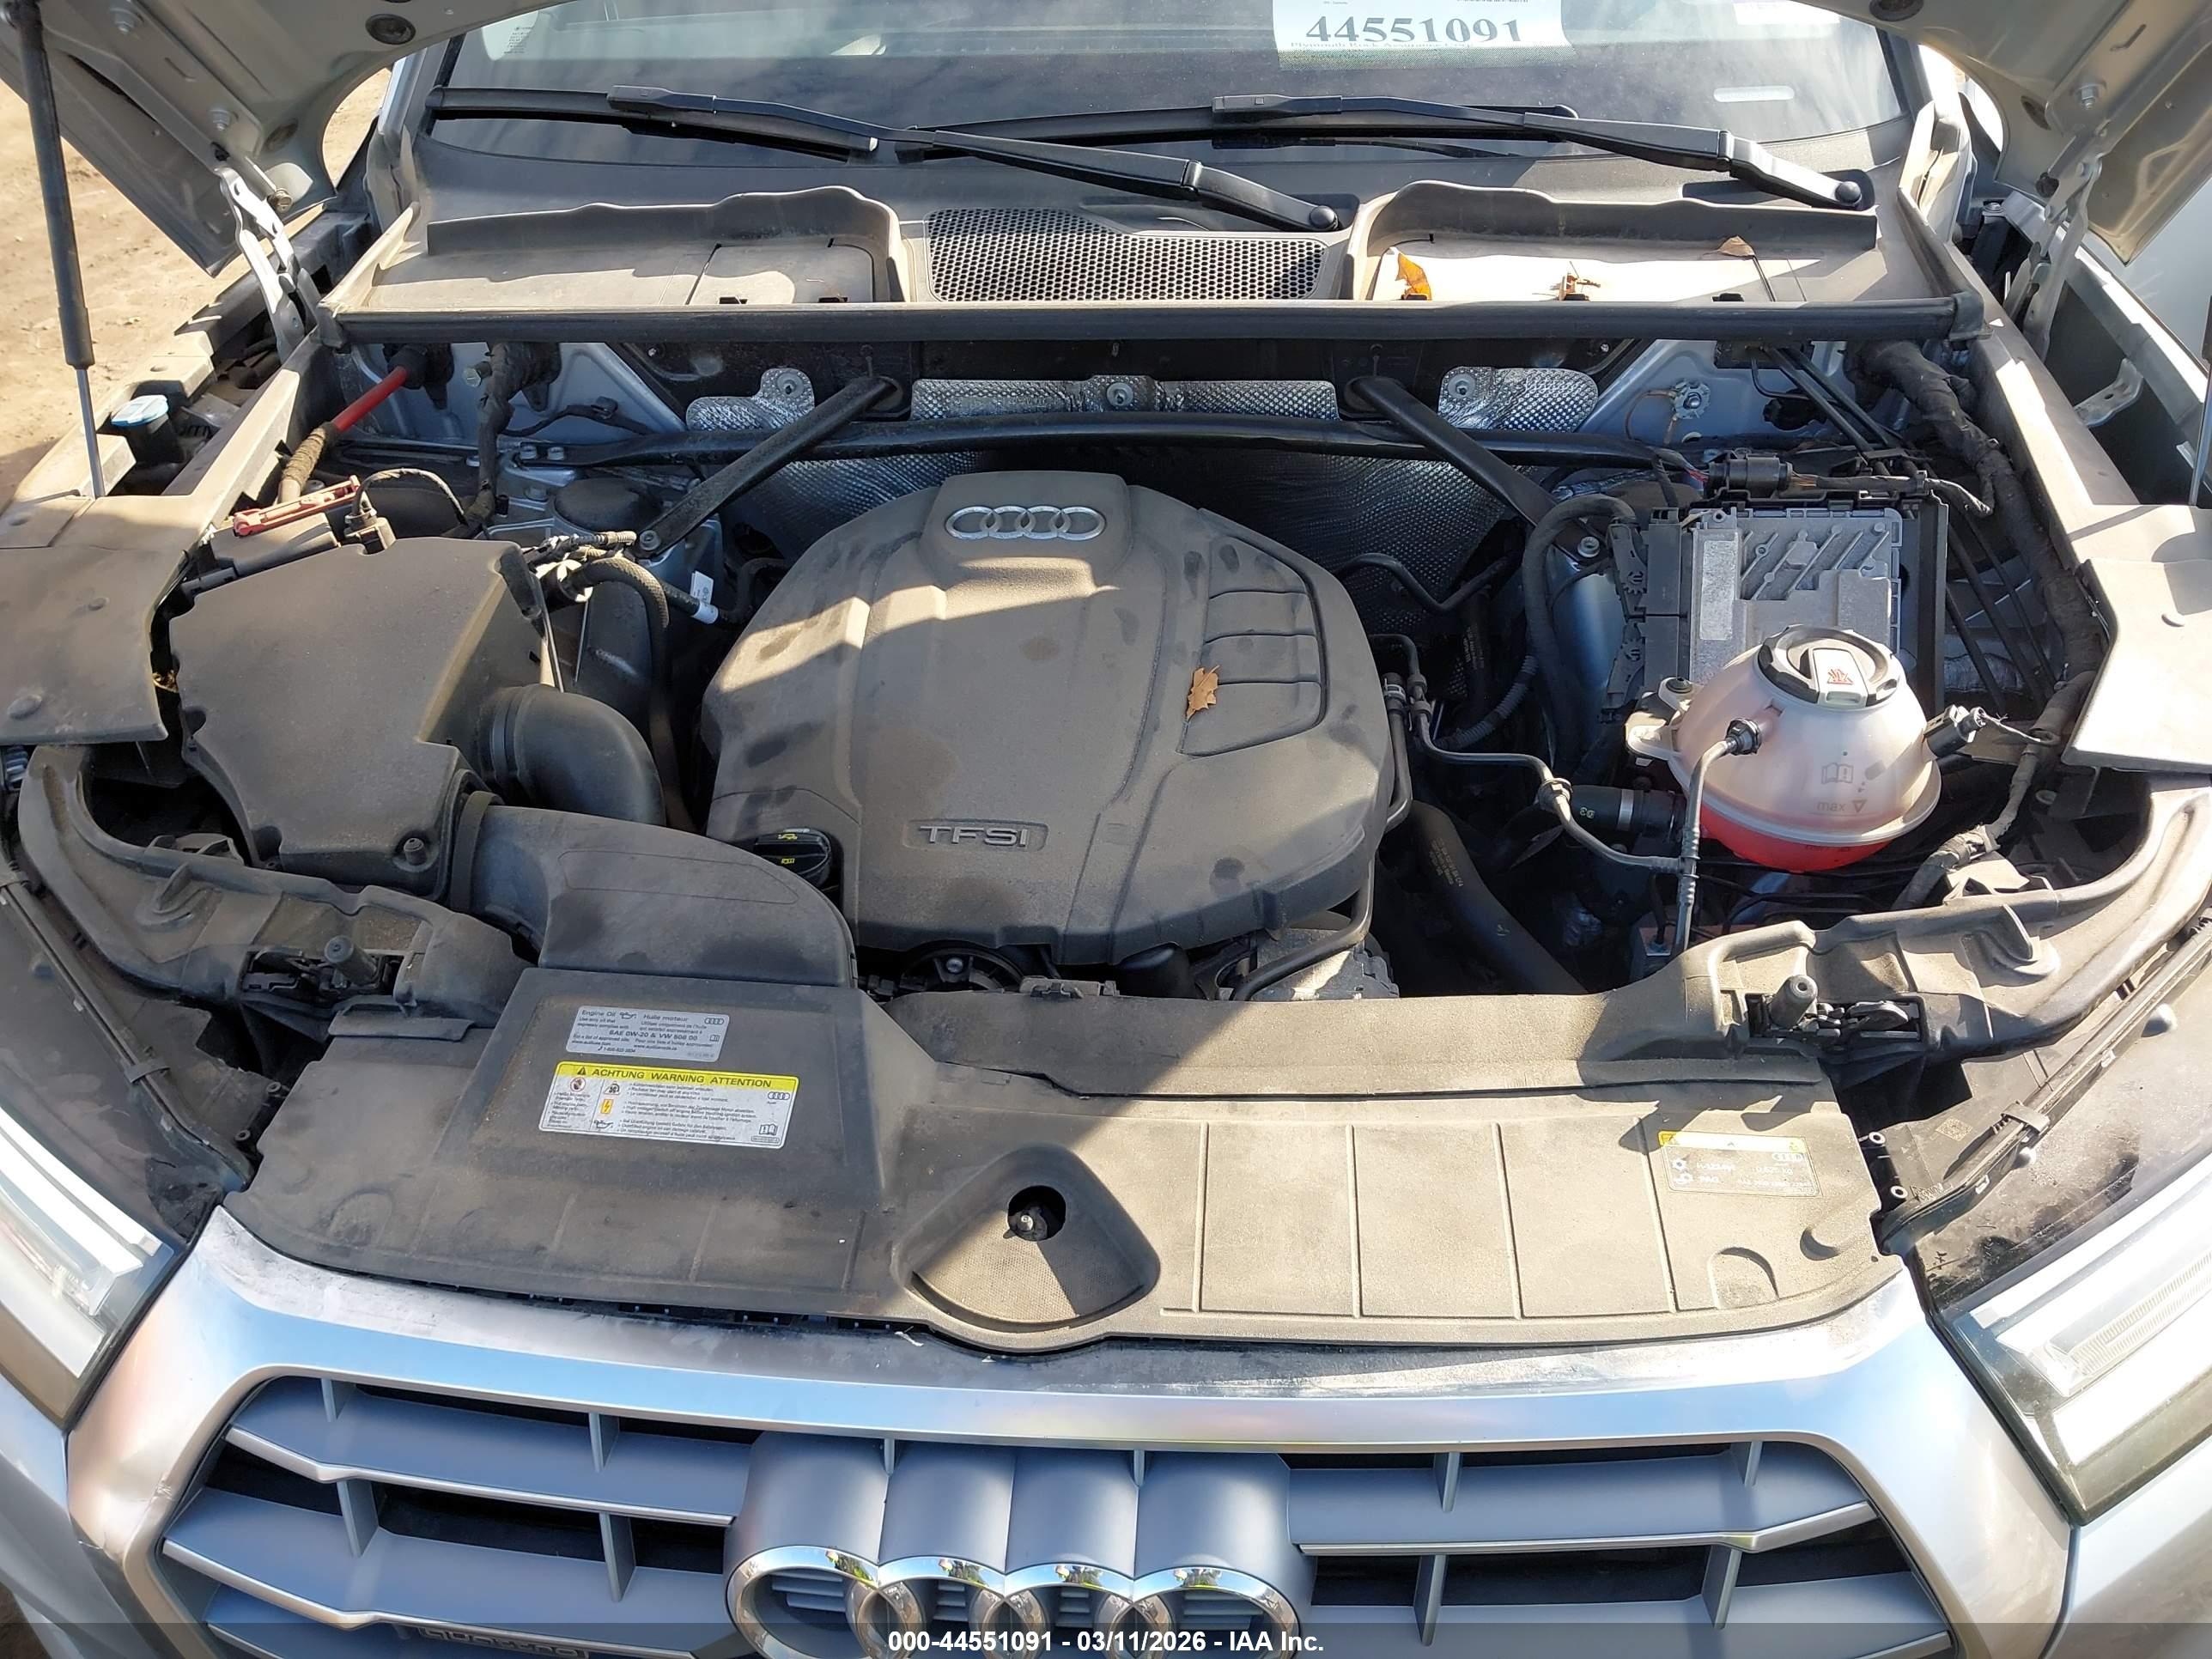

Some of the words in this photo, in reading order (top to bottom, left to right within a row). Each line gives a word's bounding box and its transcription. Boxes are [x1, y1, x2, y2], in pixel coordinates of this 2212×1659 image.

[1306, 15, 1522, 42] 44551091
[1816, 801, 1846, 811] max
[918, 825, 1028, 848] TFSI
[592, 1069, 645, 1079] ACHTUNG
[651, 1073, 704, 1083] WARNING
[709, 1077, 772, 1087] ATTENTION
